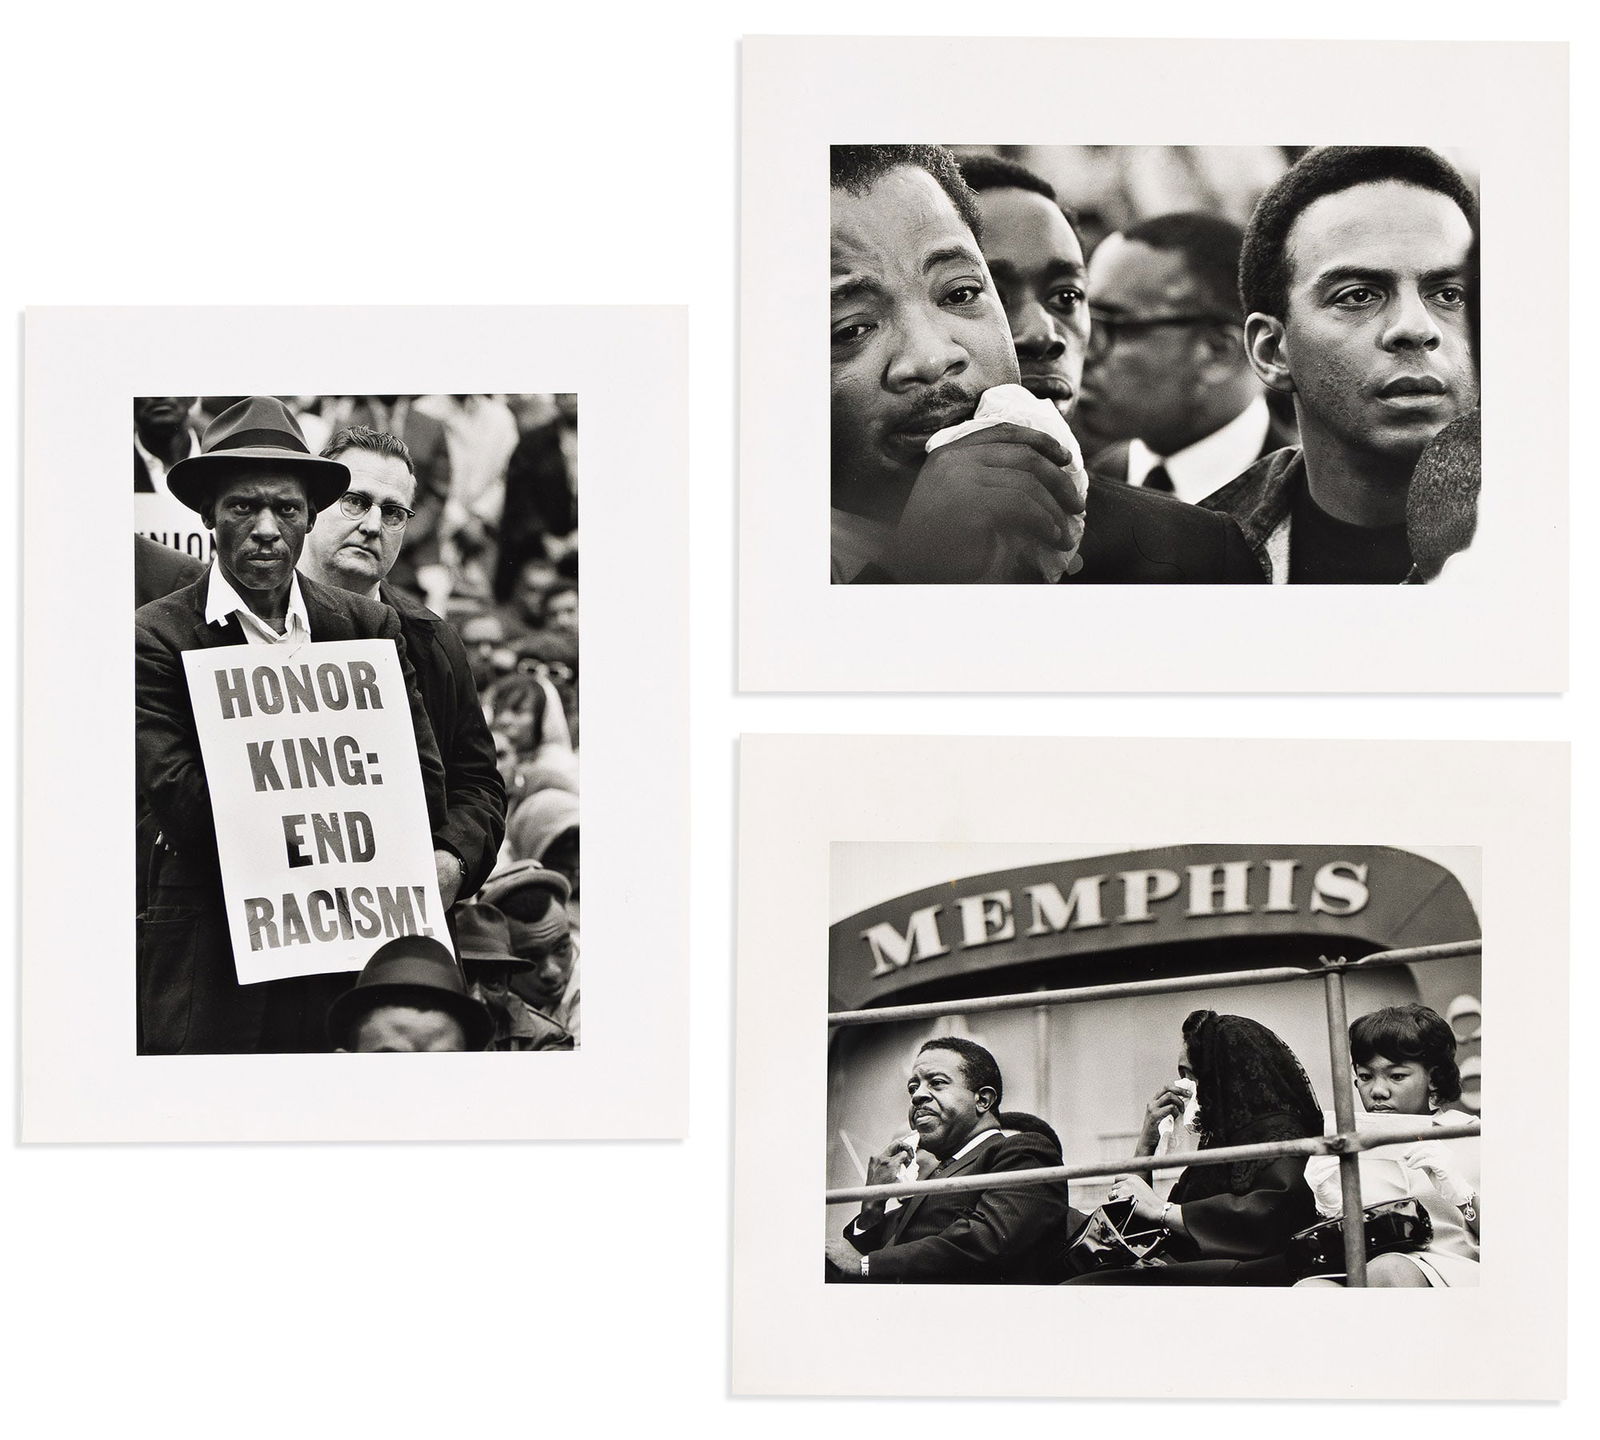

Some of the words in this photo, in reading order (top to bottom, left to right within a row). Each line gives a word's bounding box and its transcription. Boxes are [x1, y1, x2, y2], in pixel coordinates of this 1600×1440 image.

[214, 661, 384, 719] HONOR
[246, 735, 383, 792] KING:
[281, 811, 376, 869] END
[243, 886, 435, 952] RACISM!
[861, 860, 1370, 978] MEMPHIS
